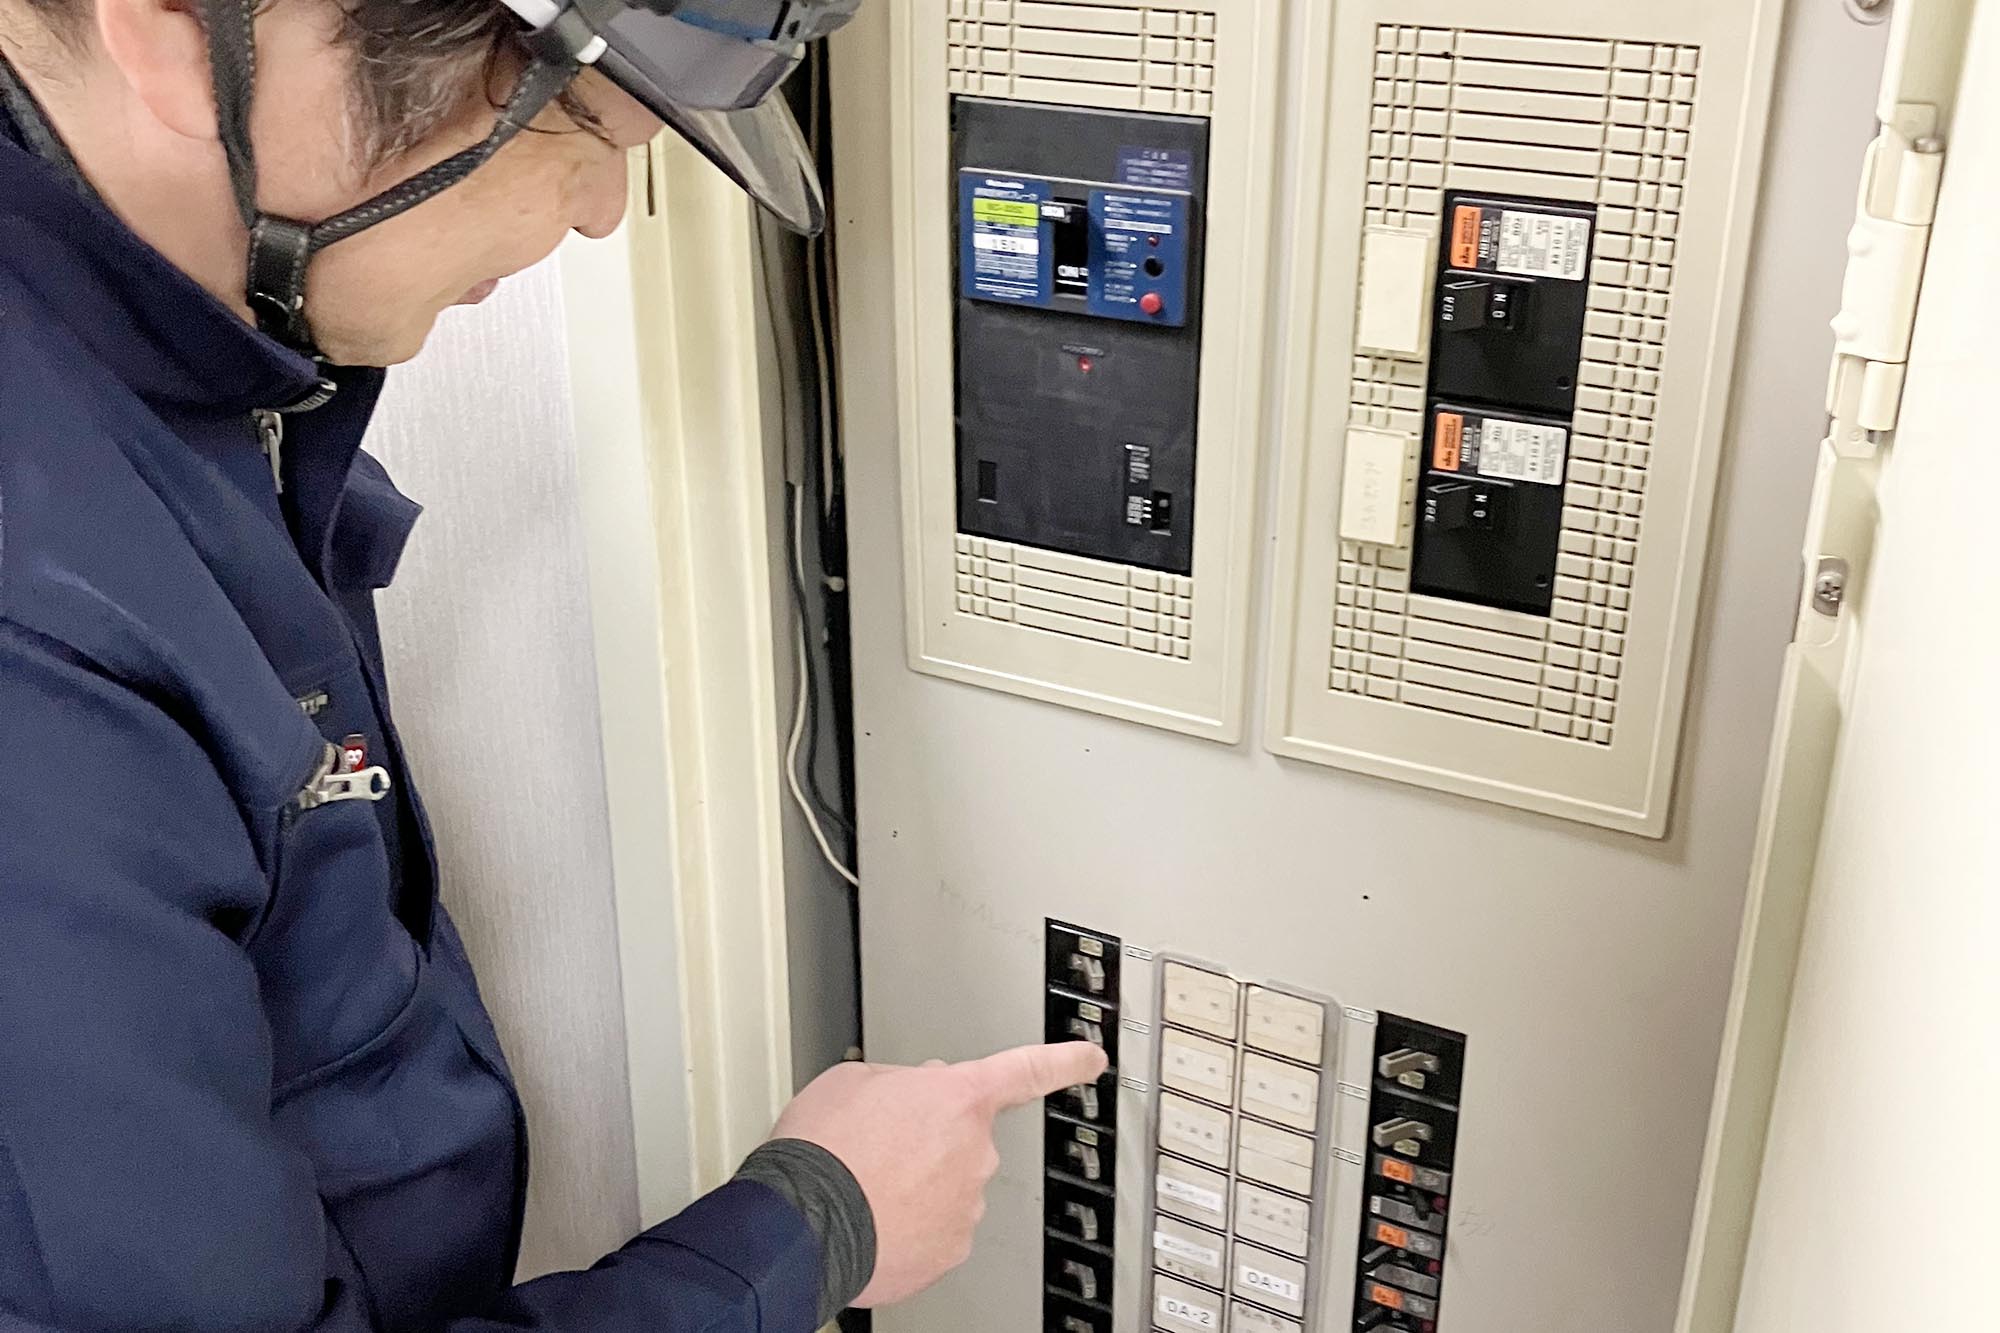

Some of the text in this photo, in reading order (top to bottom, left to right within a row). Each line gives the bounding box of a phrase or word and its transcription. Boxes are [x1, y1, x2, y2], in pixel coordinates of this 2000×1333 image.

[1492, 293, 1508, 319] ON
[1473, 494, 1488, 518] ON
[1247, 1271, 1291, 1296] OA-1
